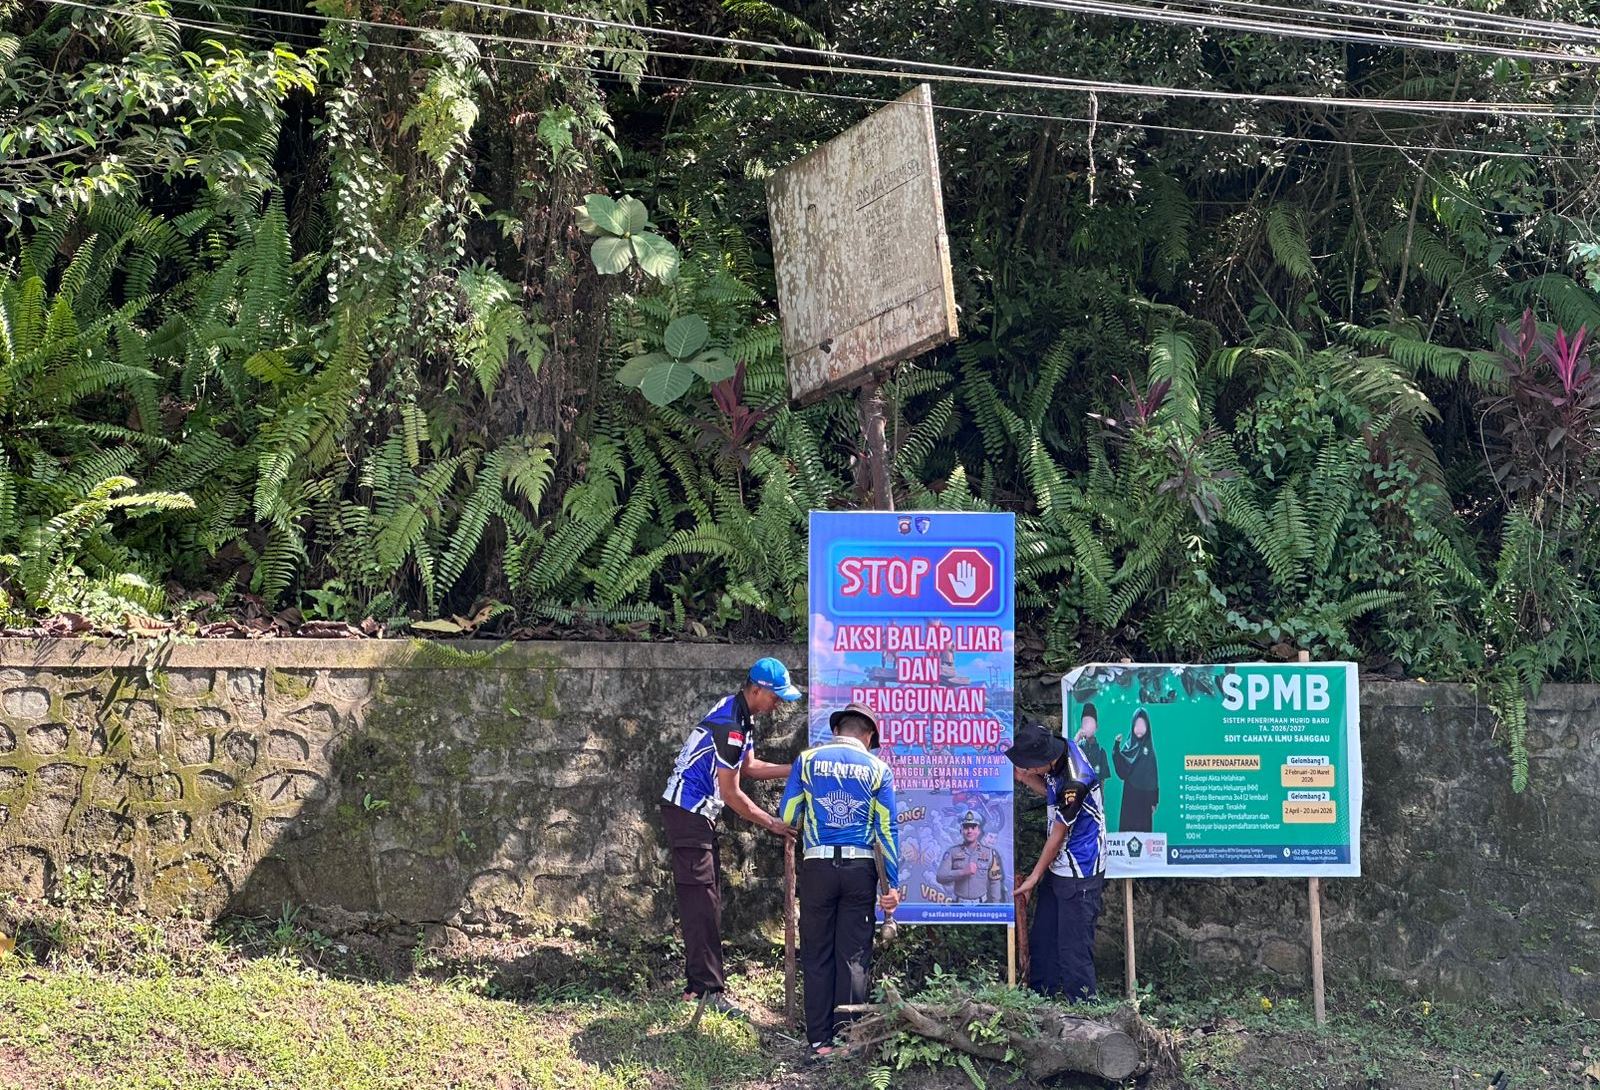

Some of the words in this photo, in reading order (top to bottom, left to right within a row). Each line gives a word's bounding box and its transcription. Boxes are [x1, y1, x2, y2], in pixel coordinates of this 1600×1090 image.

[839, 557, 929, 596] STOP
[835, 627, 881, 650] AKSI
[887, 627, 952, 650] BALAP
[956, 627, 1001, 650] LIAR
[898, 658, 938, 681] DAN
[1222, 673, 1330, 711] SPMB
[853, 689, 984, 713] PENGGUNAAN
[933, 720, 1000, 744] BRONG
[1224, 734, 1241, 742] SDIT
[1242, 734, 1273, 742] CAHAYA
[1274, 734, 1292, 742] ILMU
[1294, 734, 1330, 742] SANGGAU
[900, 755, 972, 765] MEMBAHAYAKAN
[975, 755, 1006, 765] NYAWA
[1186, 759, 1211, 767] SYARAT
[1212, 759, 1259, 767] PENDAFTARAN
[1290, 757, 1321, 765] Gelombang
[928, 767, 969, 777] KEMANAN
[973, 767, 999, 777] SERTA
[921, 779, 979, 789] MASYARAKAT
[1290, 793, 1321, 801] Gelombang
[1289, 807, 1299, 815] April
